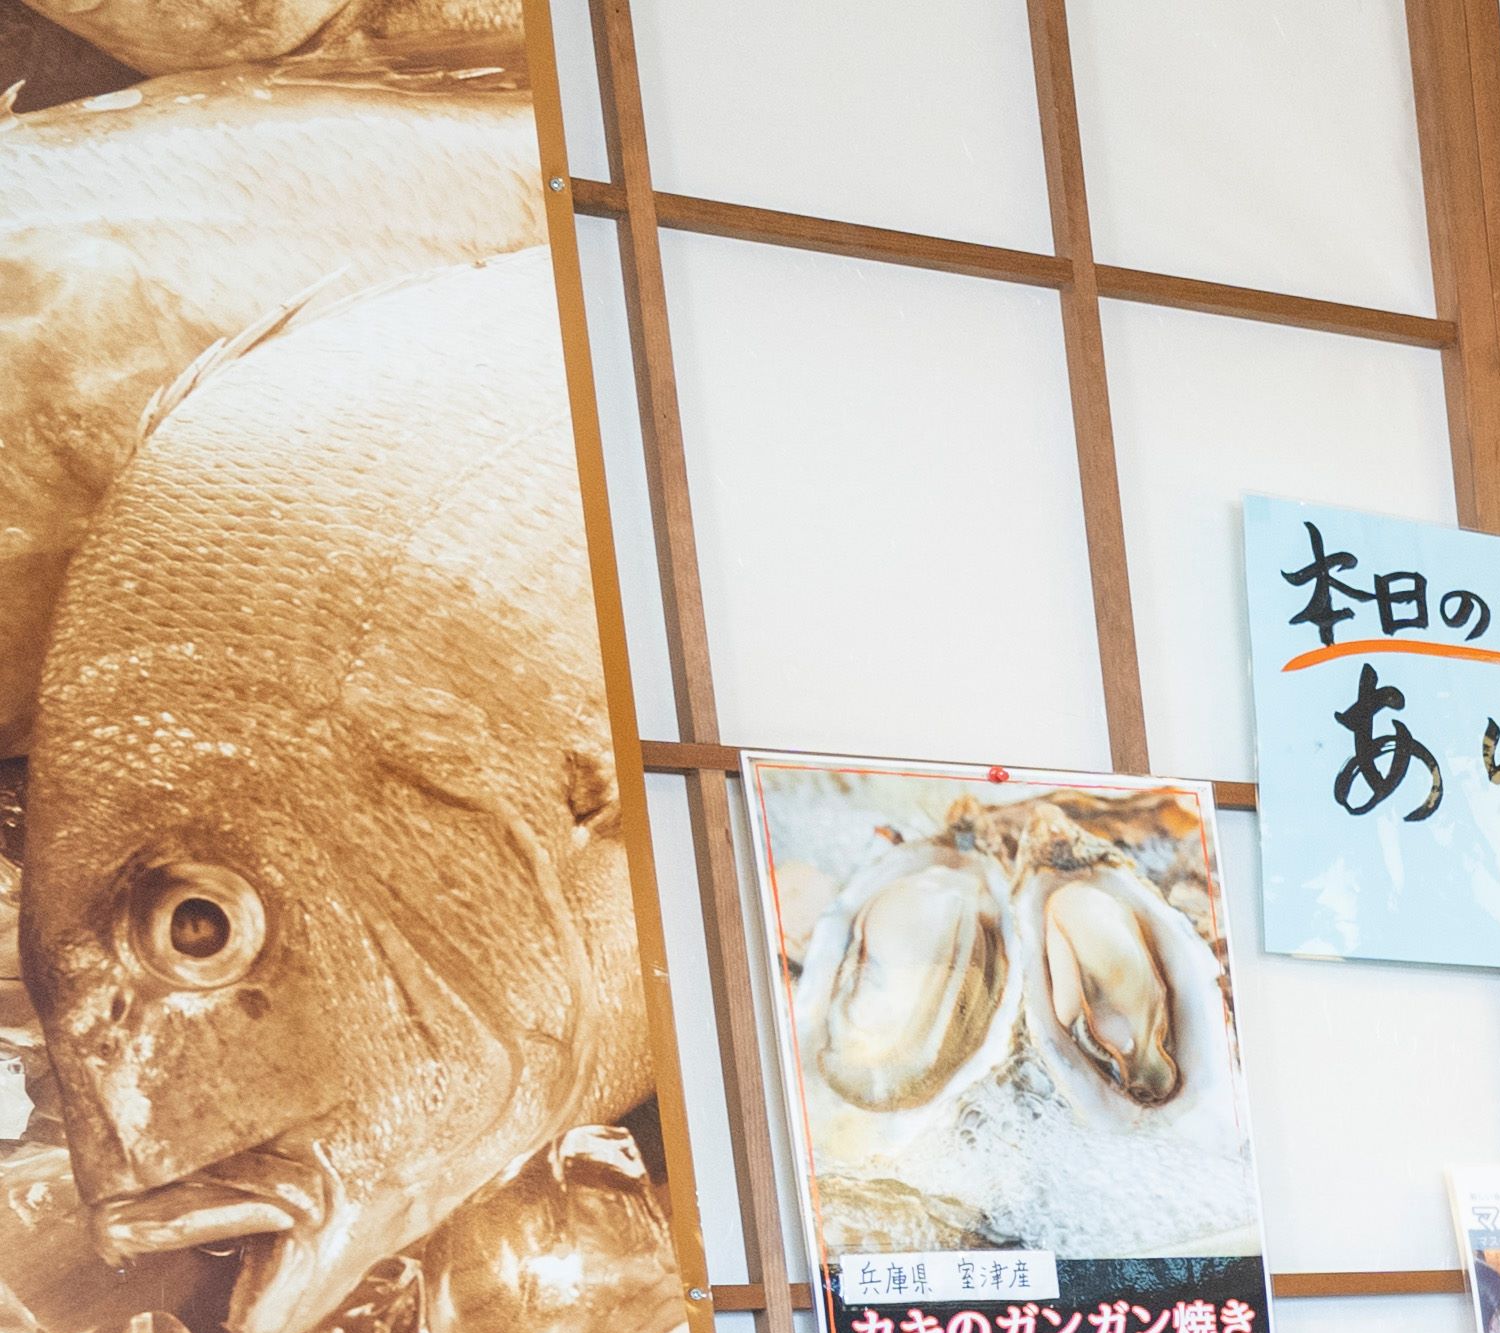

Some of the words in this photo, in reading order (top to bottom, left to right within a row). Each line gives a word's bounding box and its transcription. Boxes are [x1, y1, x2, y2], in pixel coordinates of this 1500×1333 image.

[858, 1261, 933, 1295] 兵庫県
[957, 1257, 1031, 1290] 室津産
